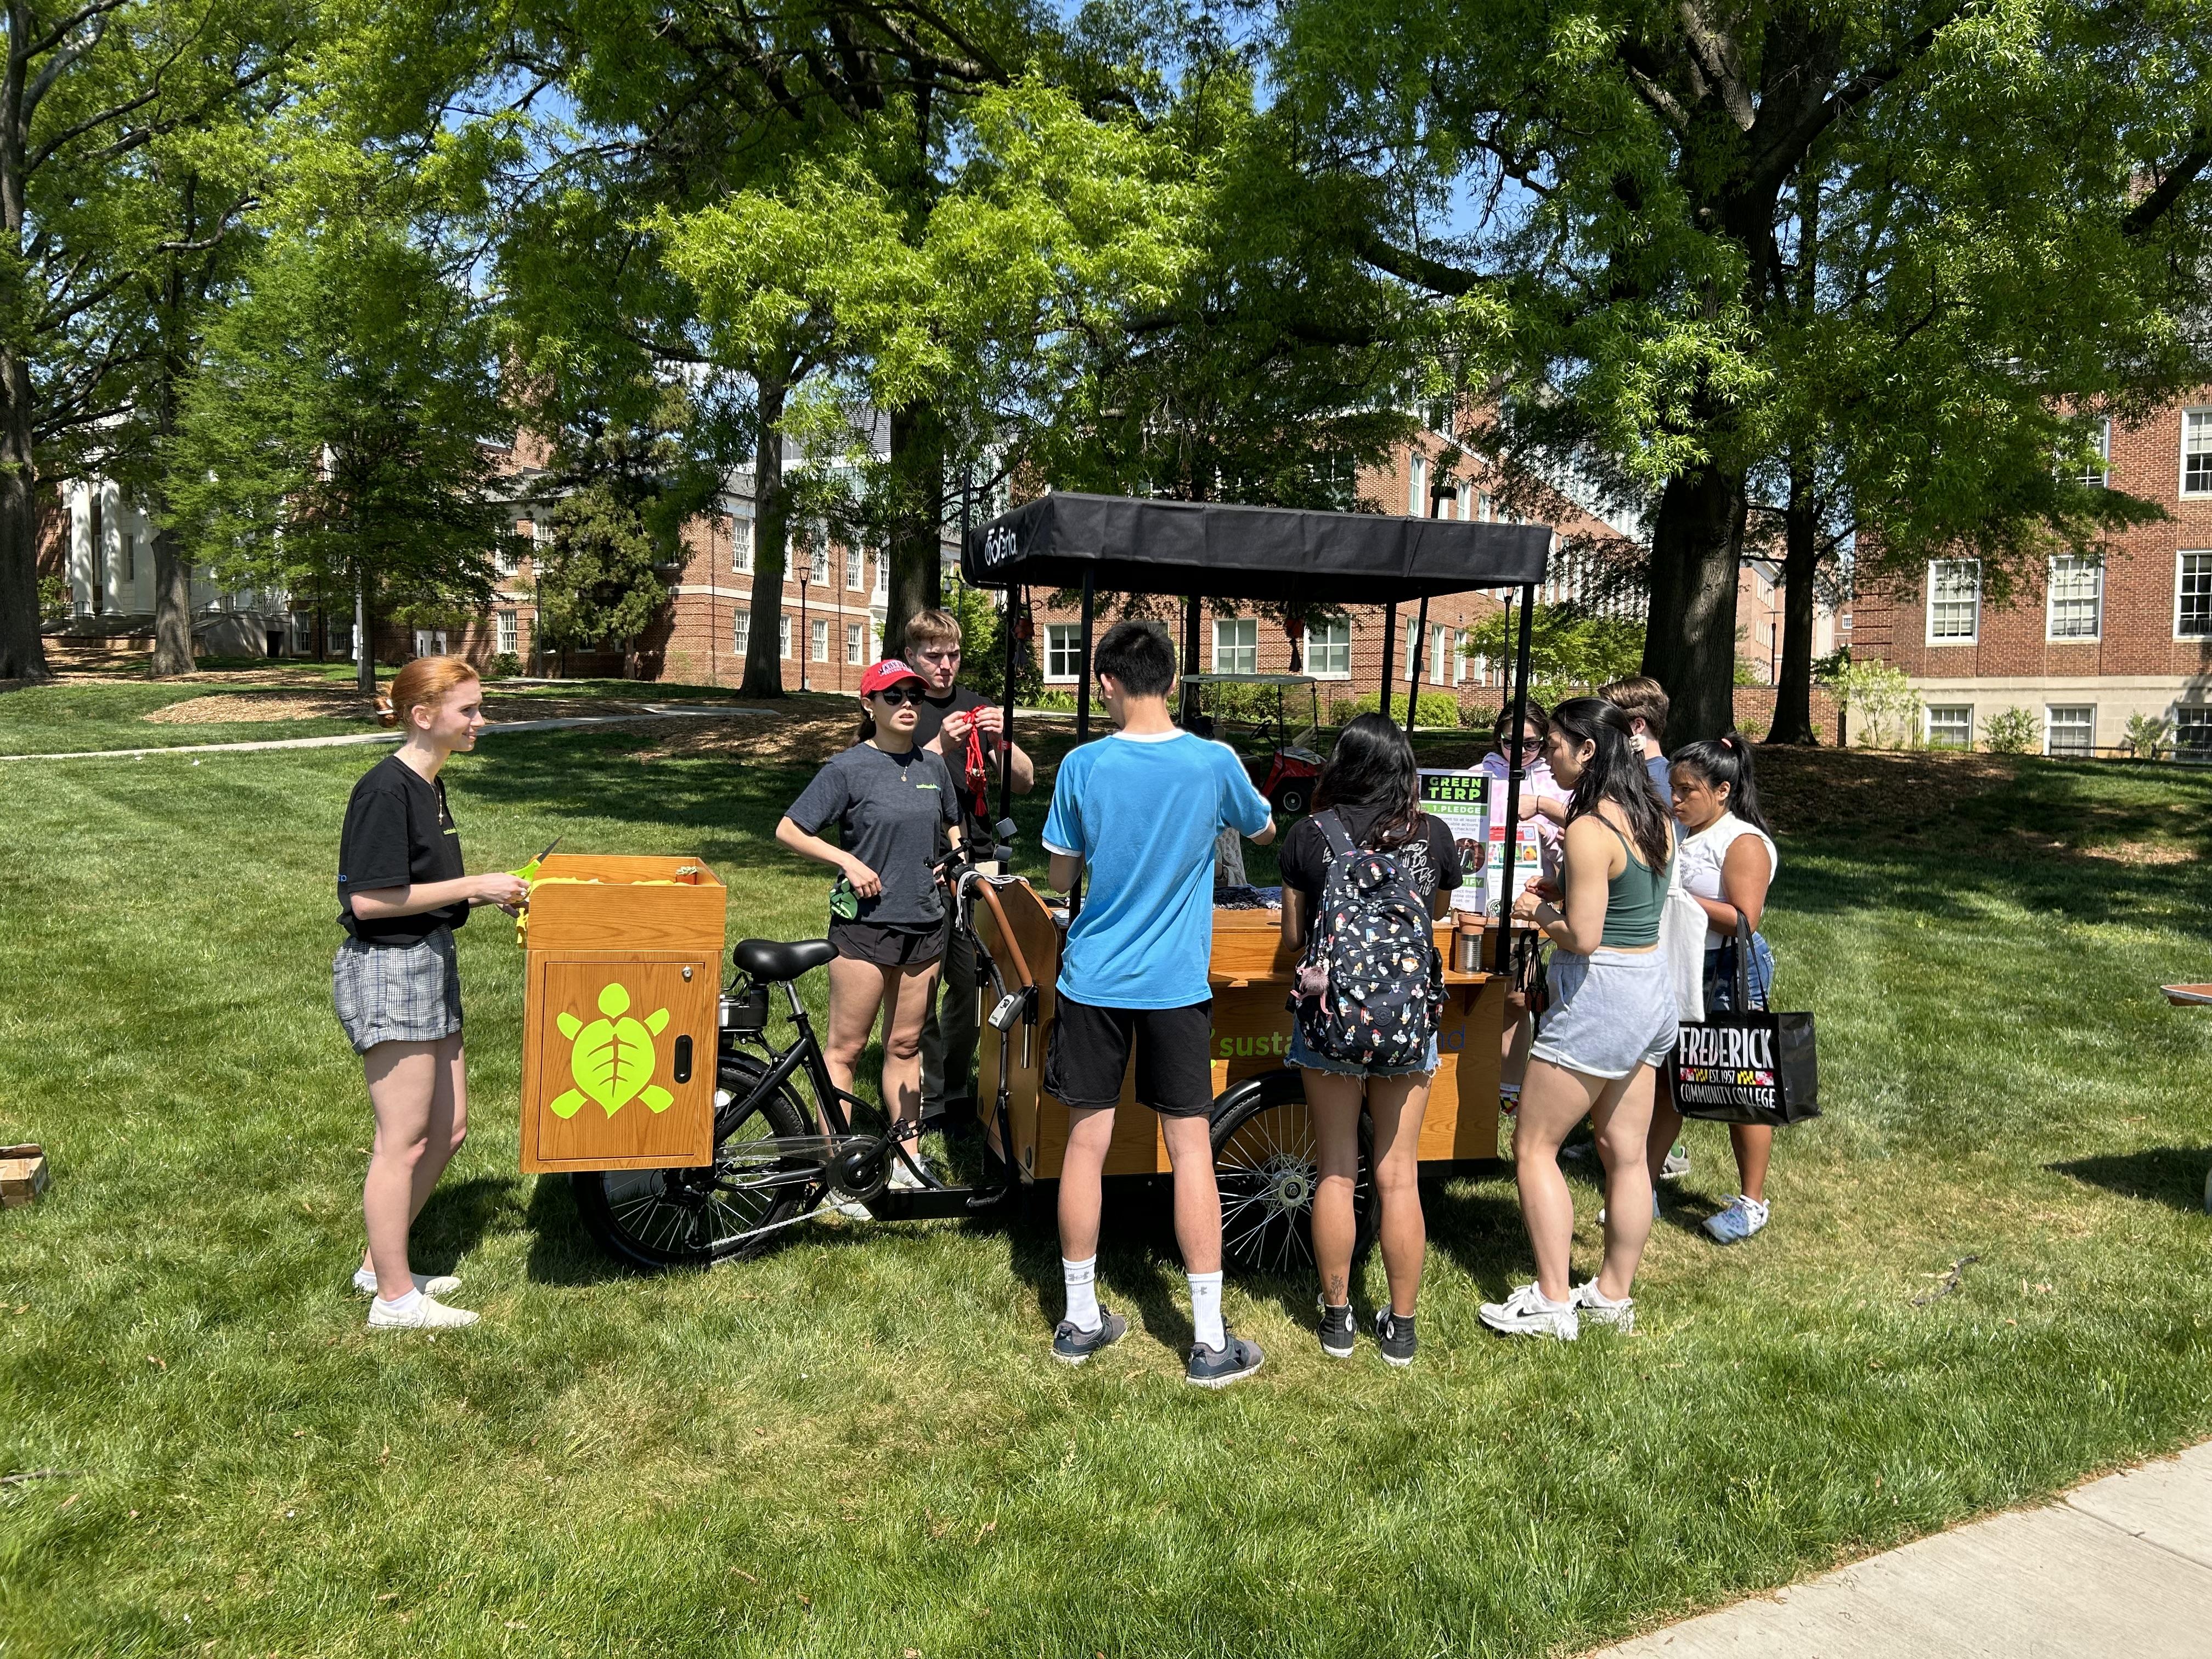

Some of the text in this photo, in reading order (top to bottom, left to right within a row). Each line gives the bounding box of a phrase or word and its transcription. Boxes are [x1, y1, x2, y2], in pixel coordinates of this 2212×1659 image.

[1429, 776, 1481, 788] GREEN
[1428, 787, 1481, 800] TERP
[1679, 1026, 1774, 1069] FREDERICK
[1709, 1069, 1735, 1085] EST. 1957
[1680, 1083, 1776, 1109] COMMUNITY COLLEGE
